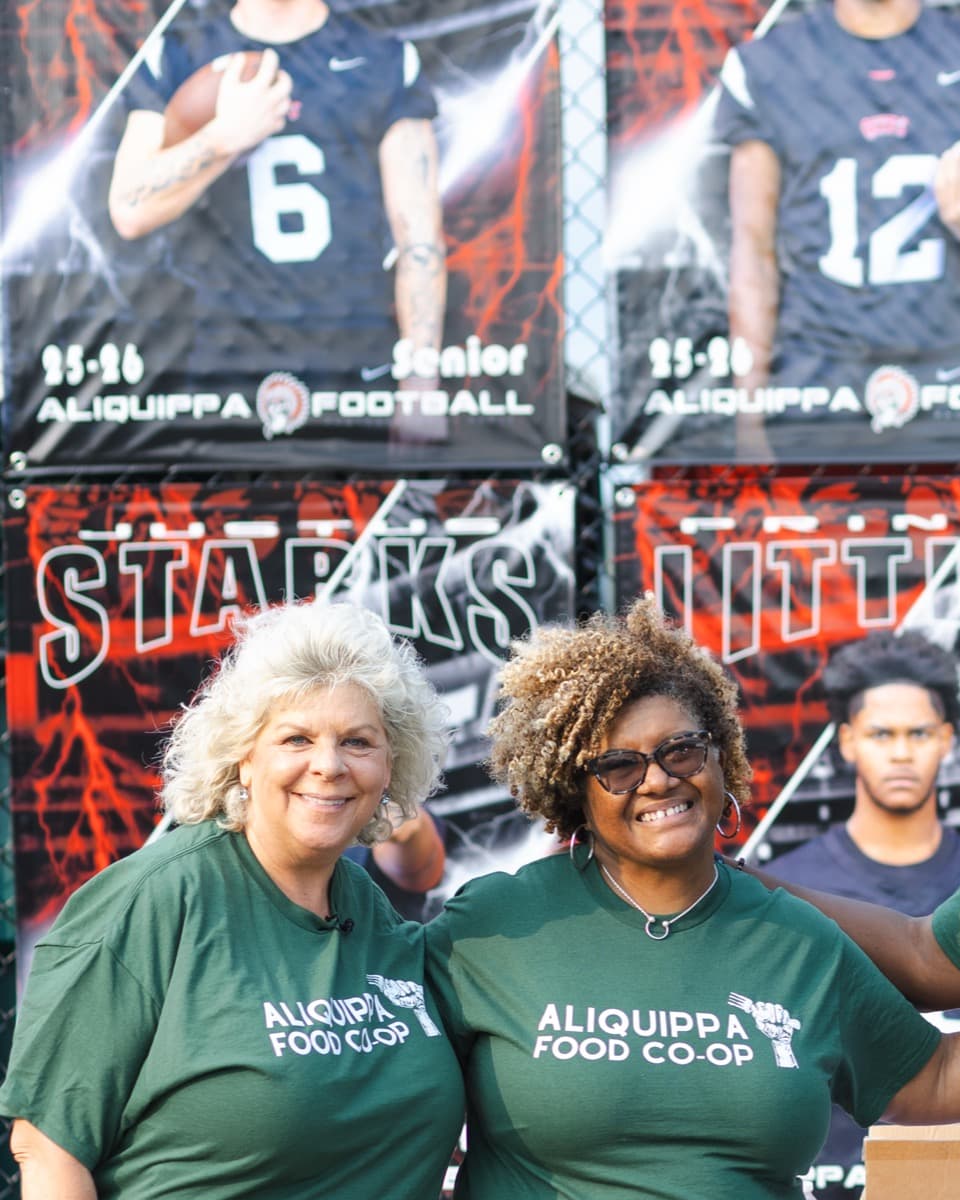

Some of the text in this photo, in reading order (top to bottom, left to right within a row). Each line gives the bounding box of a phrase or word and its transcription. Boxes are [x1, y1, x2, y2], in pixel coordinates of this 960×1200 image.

[246, 134, 332, 263] 6
[818, 153, 946, 287] 12
[390, 335, 528, 380] Senior
[37, 389, 534, 424] ALIQUIPPA FOOTBALL
[643, 385, 862, 416] ALIQUIPPA
[36, 537, 540, 689] STARKS
[263, 992, 396, 1029] ALIQUIPPA
[537, 1003, 749, 1040] ALIQUIPPA
[269, 1021, 410, 1057] FOOD CO-OP
[533, 1035, 754, 1066] FOOD CO-OP
